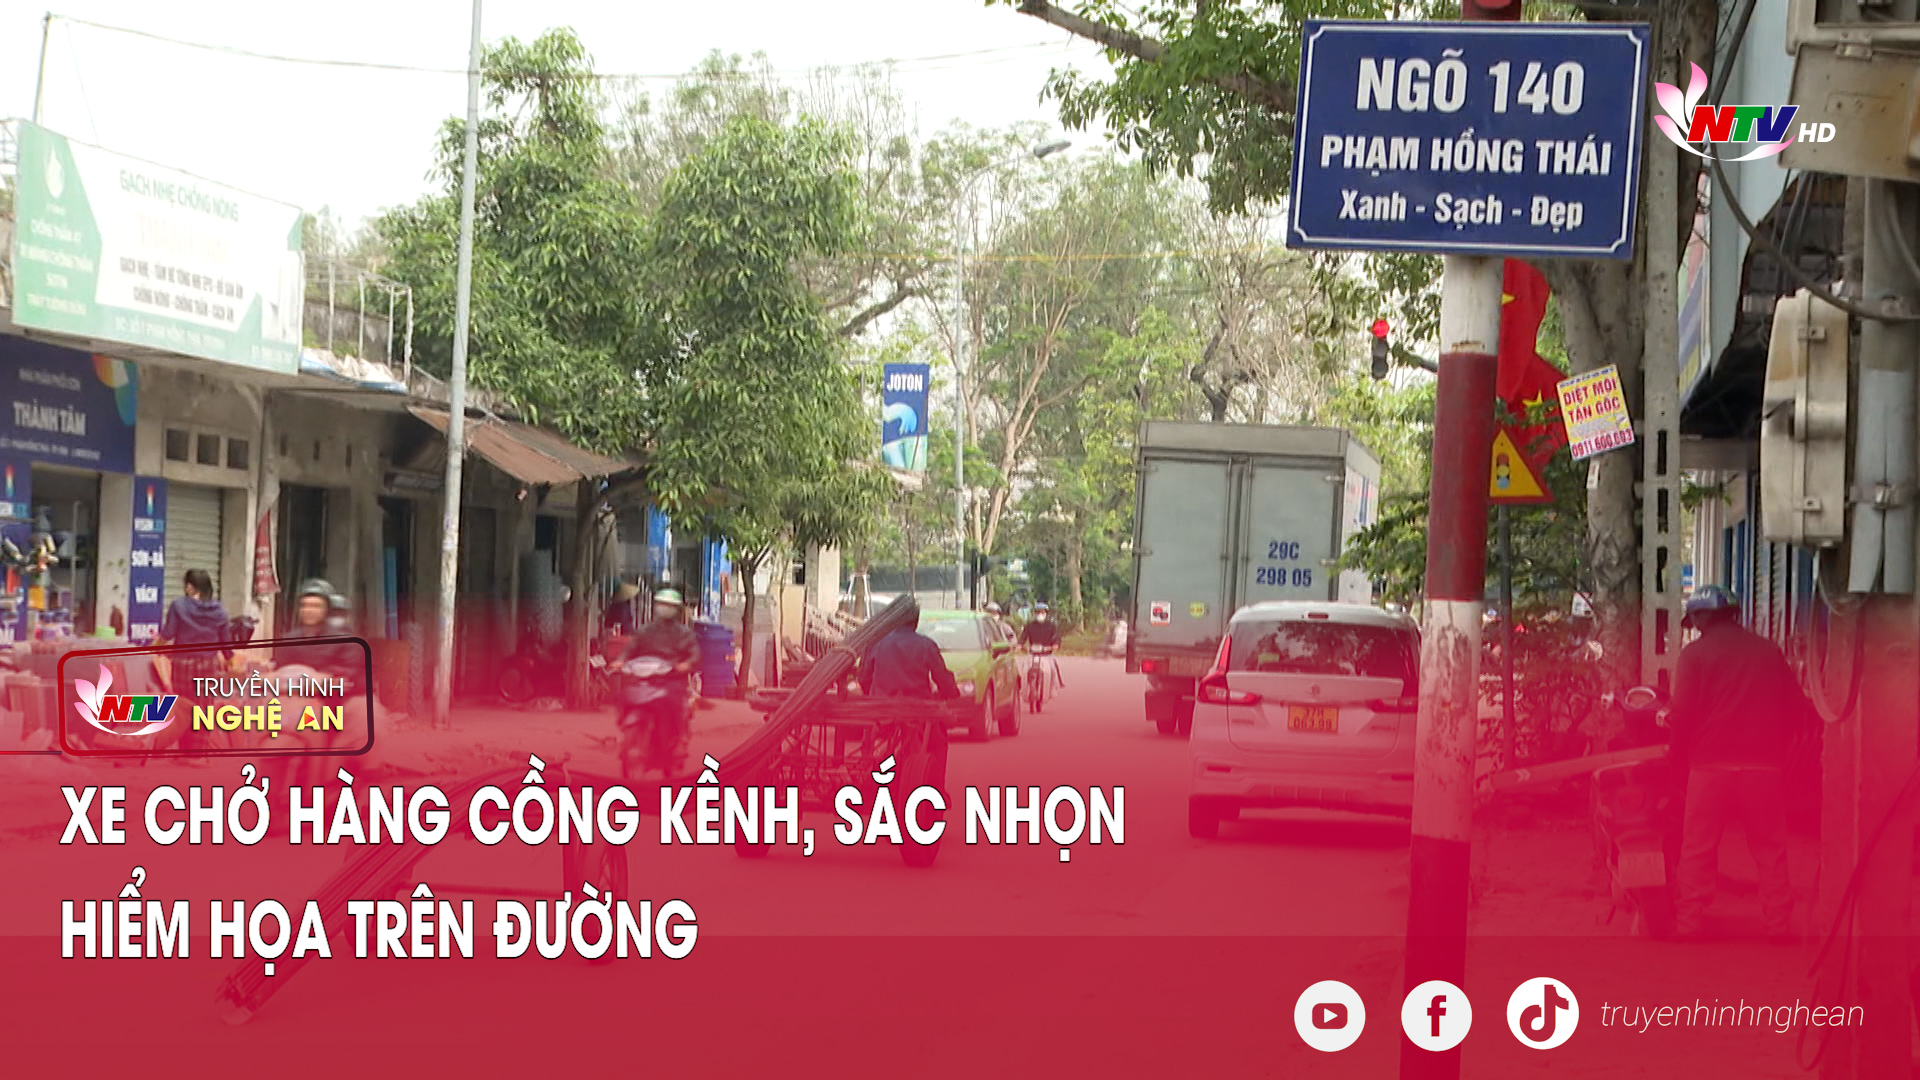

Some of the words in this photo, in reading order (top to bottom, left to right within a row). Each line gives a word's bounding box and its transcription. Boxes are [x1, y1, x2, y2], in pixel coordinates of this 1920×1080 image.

[1356, 48, 1468, 112] NGÕ
[1488, 61, 1584, 115] 140
[1320, 134, 1420, 177] PHẠM
[1430, 127, 1524, 173] HỒNG
[1535, 134, 1612, 175] THÁI
[1339, 189, 1407, 221] Xanh
[1434, 192, 1503, 230] Sạch
[1530, 196, 1583, 233] Đẹp
[886, 373, 923, 392] JOTON
[13, 398, 59, 432] THÀNH
[59, 404, 86, 436] TÂM
[1267, 541, 1300, 560] 29C
[1255, 566, 1287, 586] 298
[1291, 568, 1313, 587] 05
